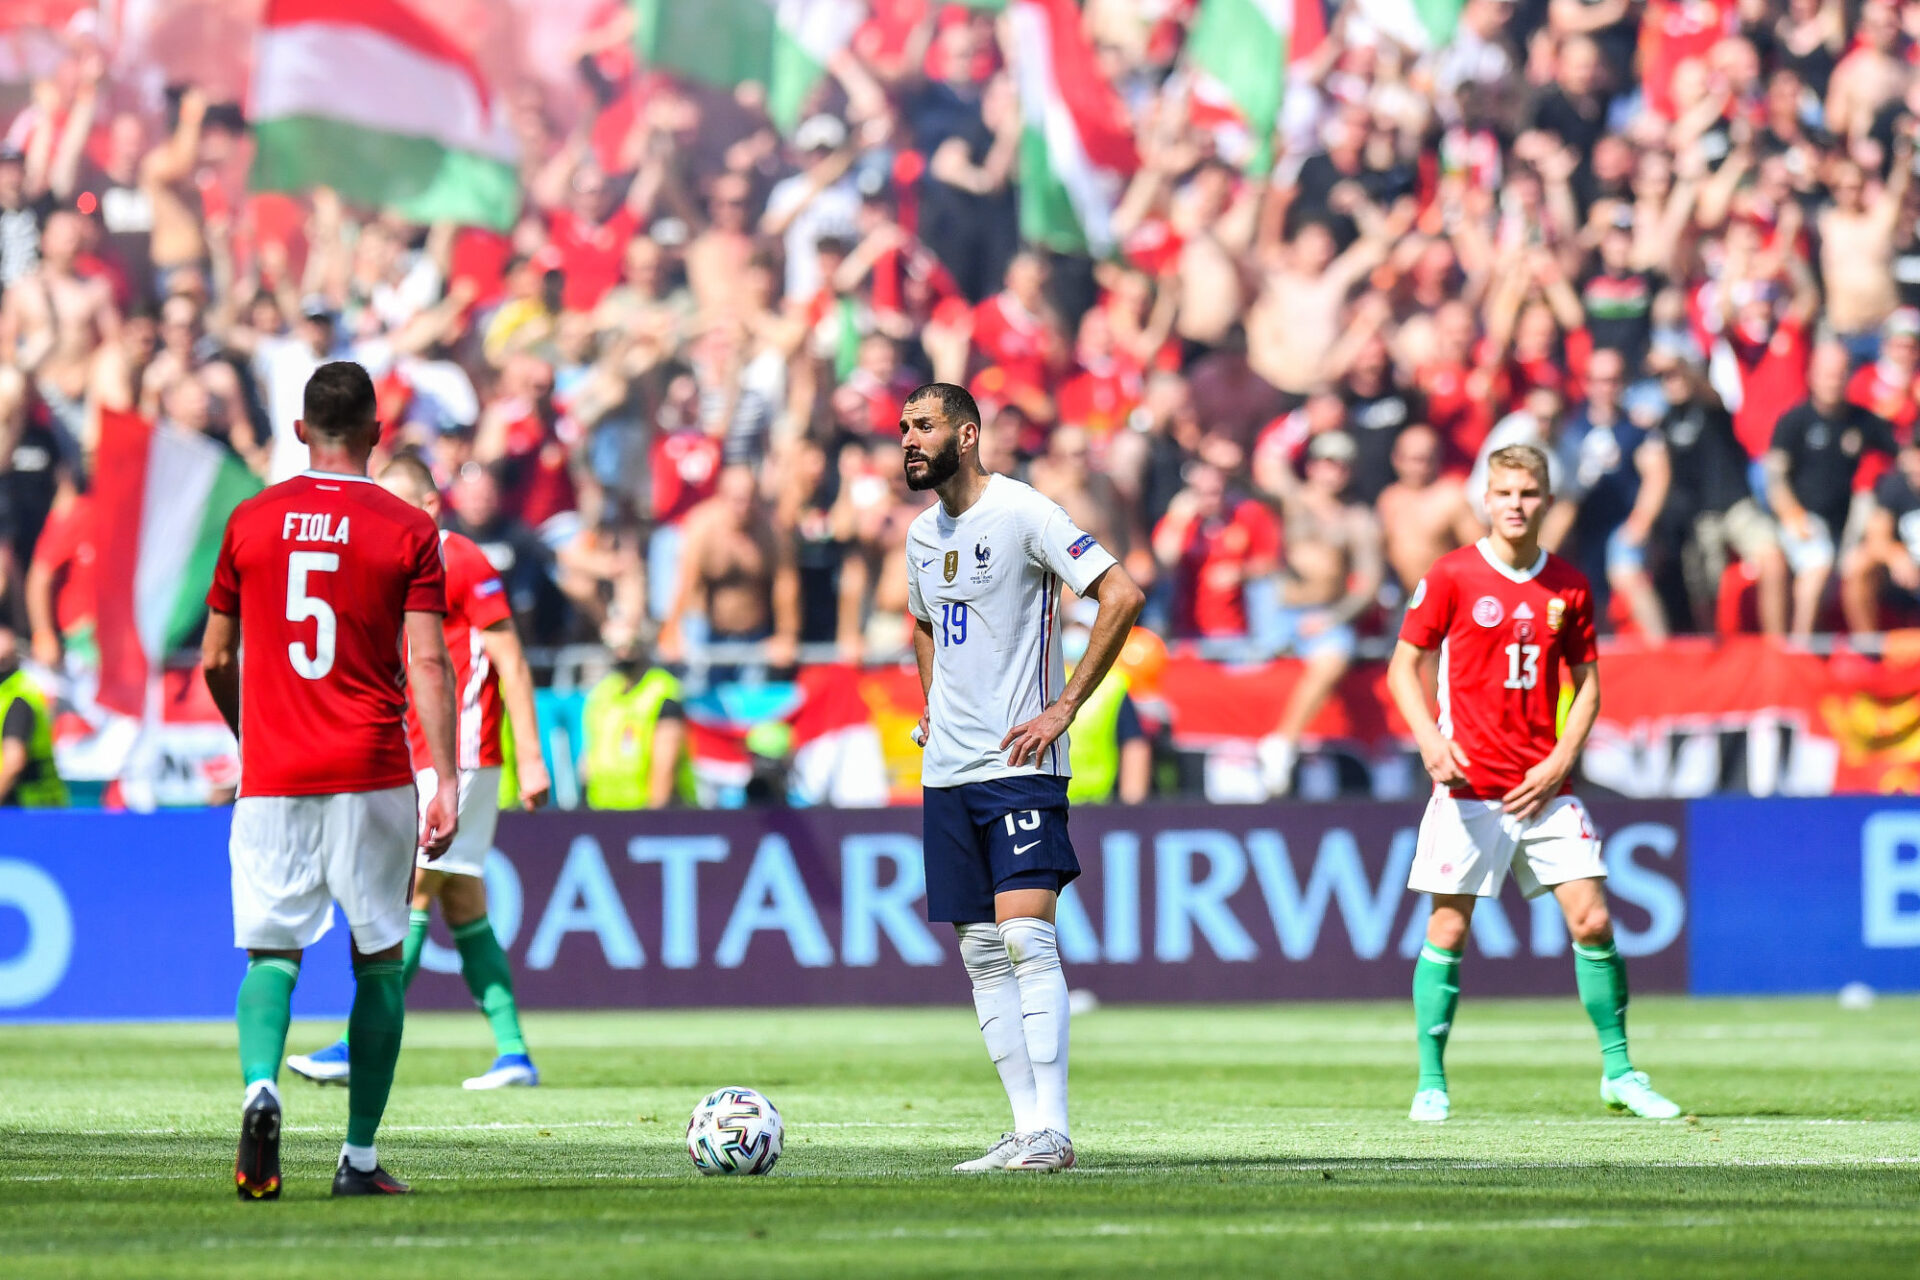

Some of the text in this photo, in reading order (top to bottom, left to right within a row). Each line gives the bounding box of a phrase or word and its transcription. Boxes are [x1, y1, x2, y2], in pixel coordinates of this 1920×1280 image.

[282, 511, 350, 545] FIOLA
[285, 550, 340, 680] 5
[942, 602, 968, 648] 19
[1503, 643, 1541, 690] 13
[1054, 822, 1687, 964] IRWS
